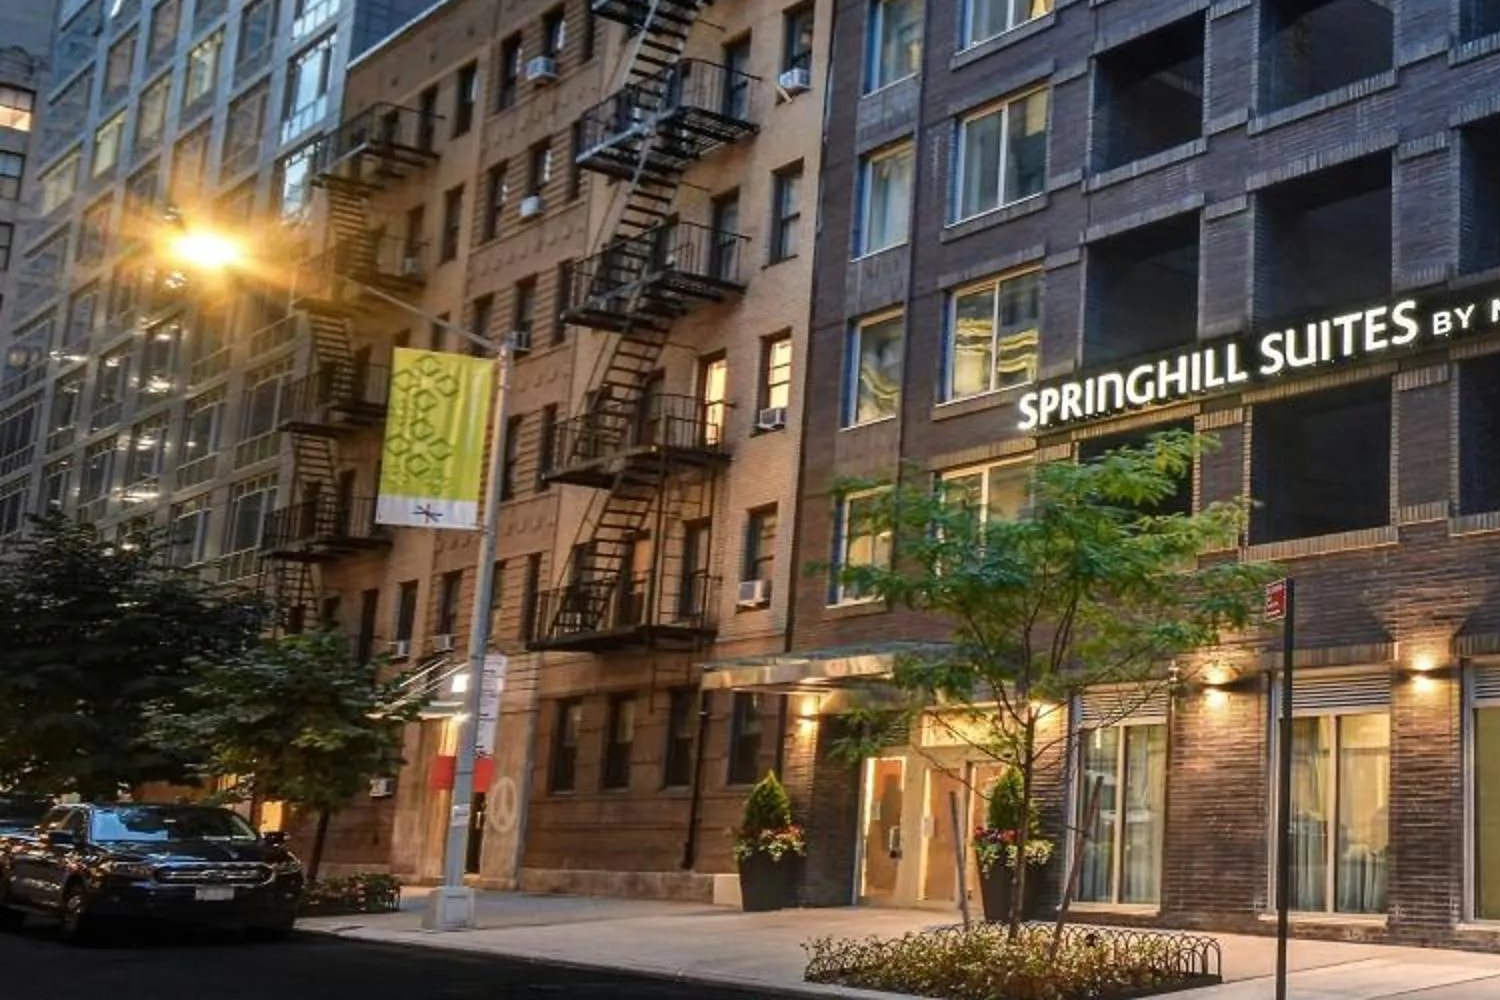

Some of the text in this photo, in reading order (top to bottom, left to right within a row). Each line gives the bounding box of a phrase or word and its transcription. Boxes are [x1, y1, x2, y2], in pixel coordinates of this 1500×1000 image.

[1017, 342, 1249, 430] SPRINGHILL
[1259, 299, 1420, 376] SUITES
[1432, 303, 1476, 335] BY
